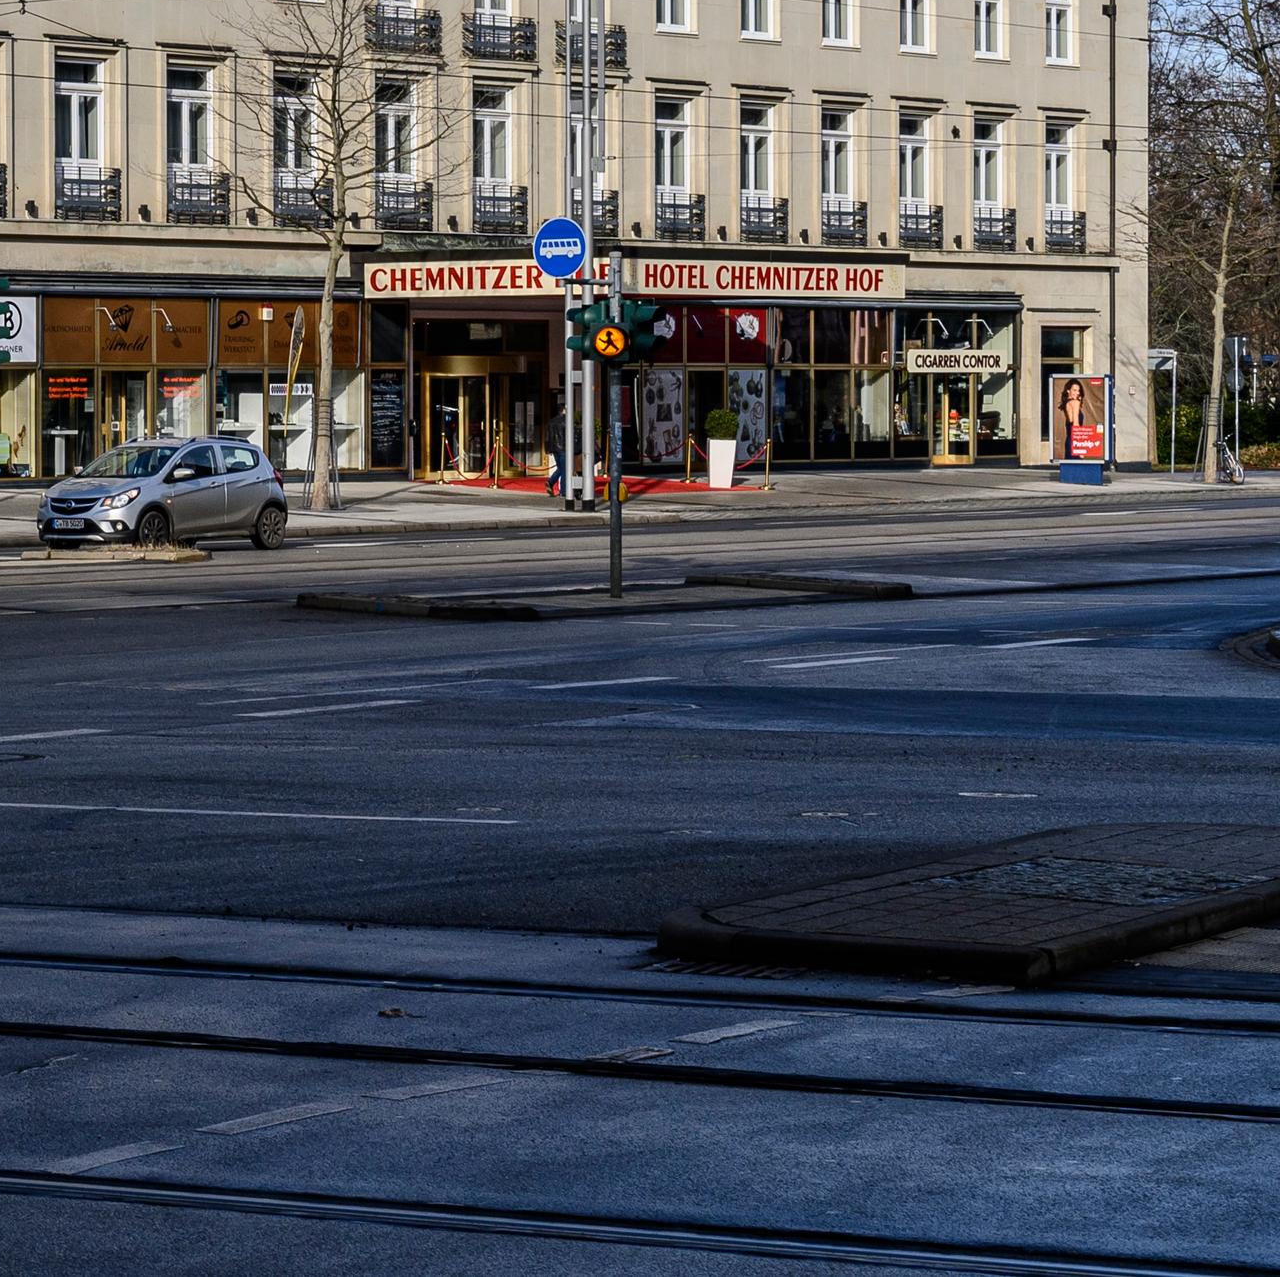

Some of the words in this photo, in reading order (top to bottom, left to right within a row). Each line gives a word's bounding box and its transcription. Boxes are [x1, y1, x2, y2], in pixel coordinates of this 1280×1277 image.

[370, 265, 543, 292] CHEMNITZER
[644, 263, 709, 289] HOTEL
[715, 265, 838, 291] CHEMNITZER
[845, 268, 884, 292] HOF
[102, 335, 150, 352] Arnold
[915, 354, 960, 368] CIGARREN
[963, 354, 1001, 368] CONTOR
